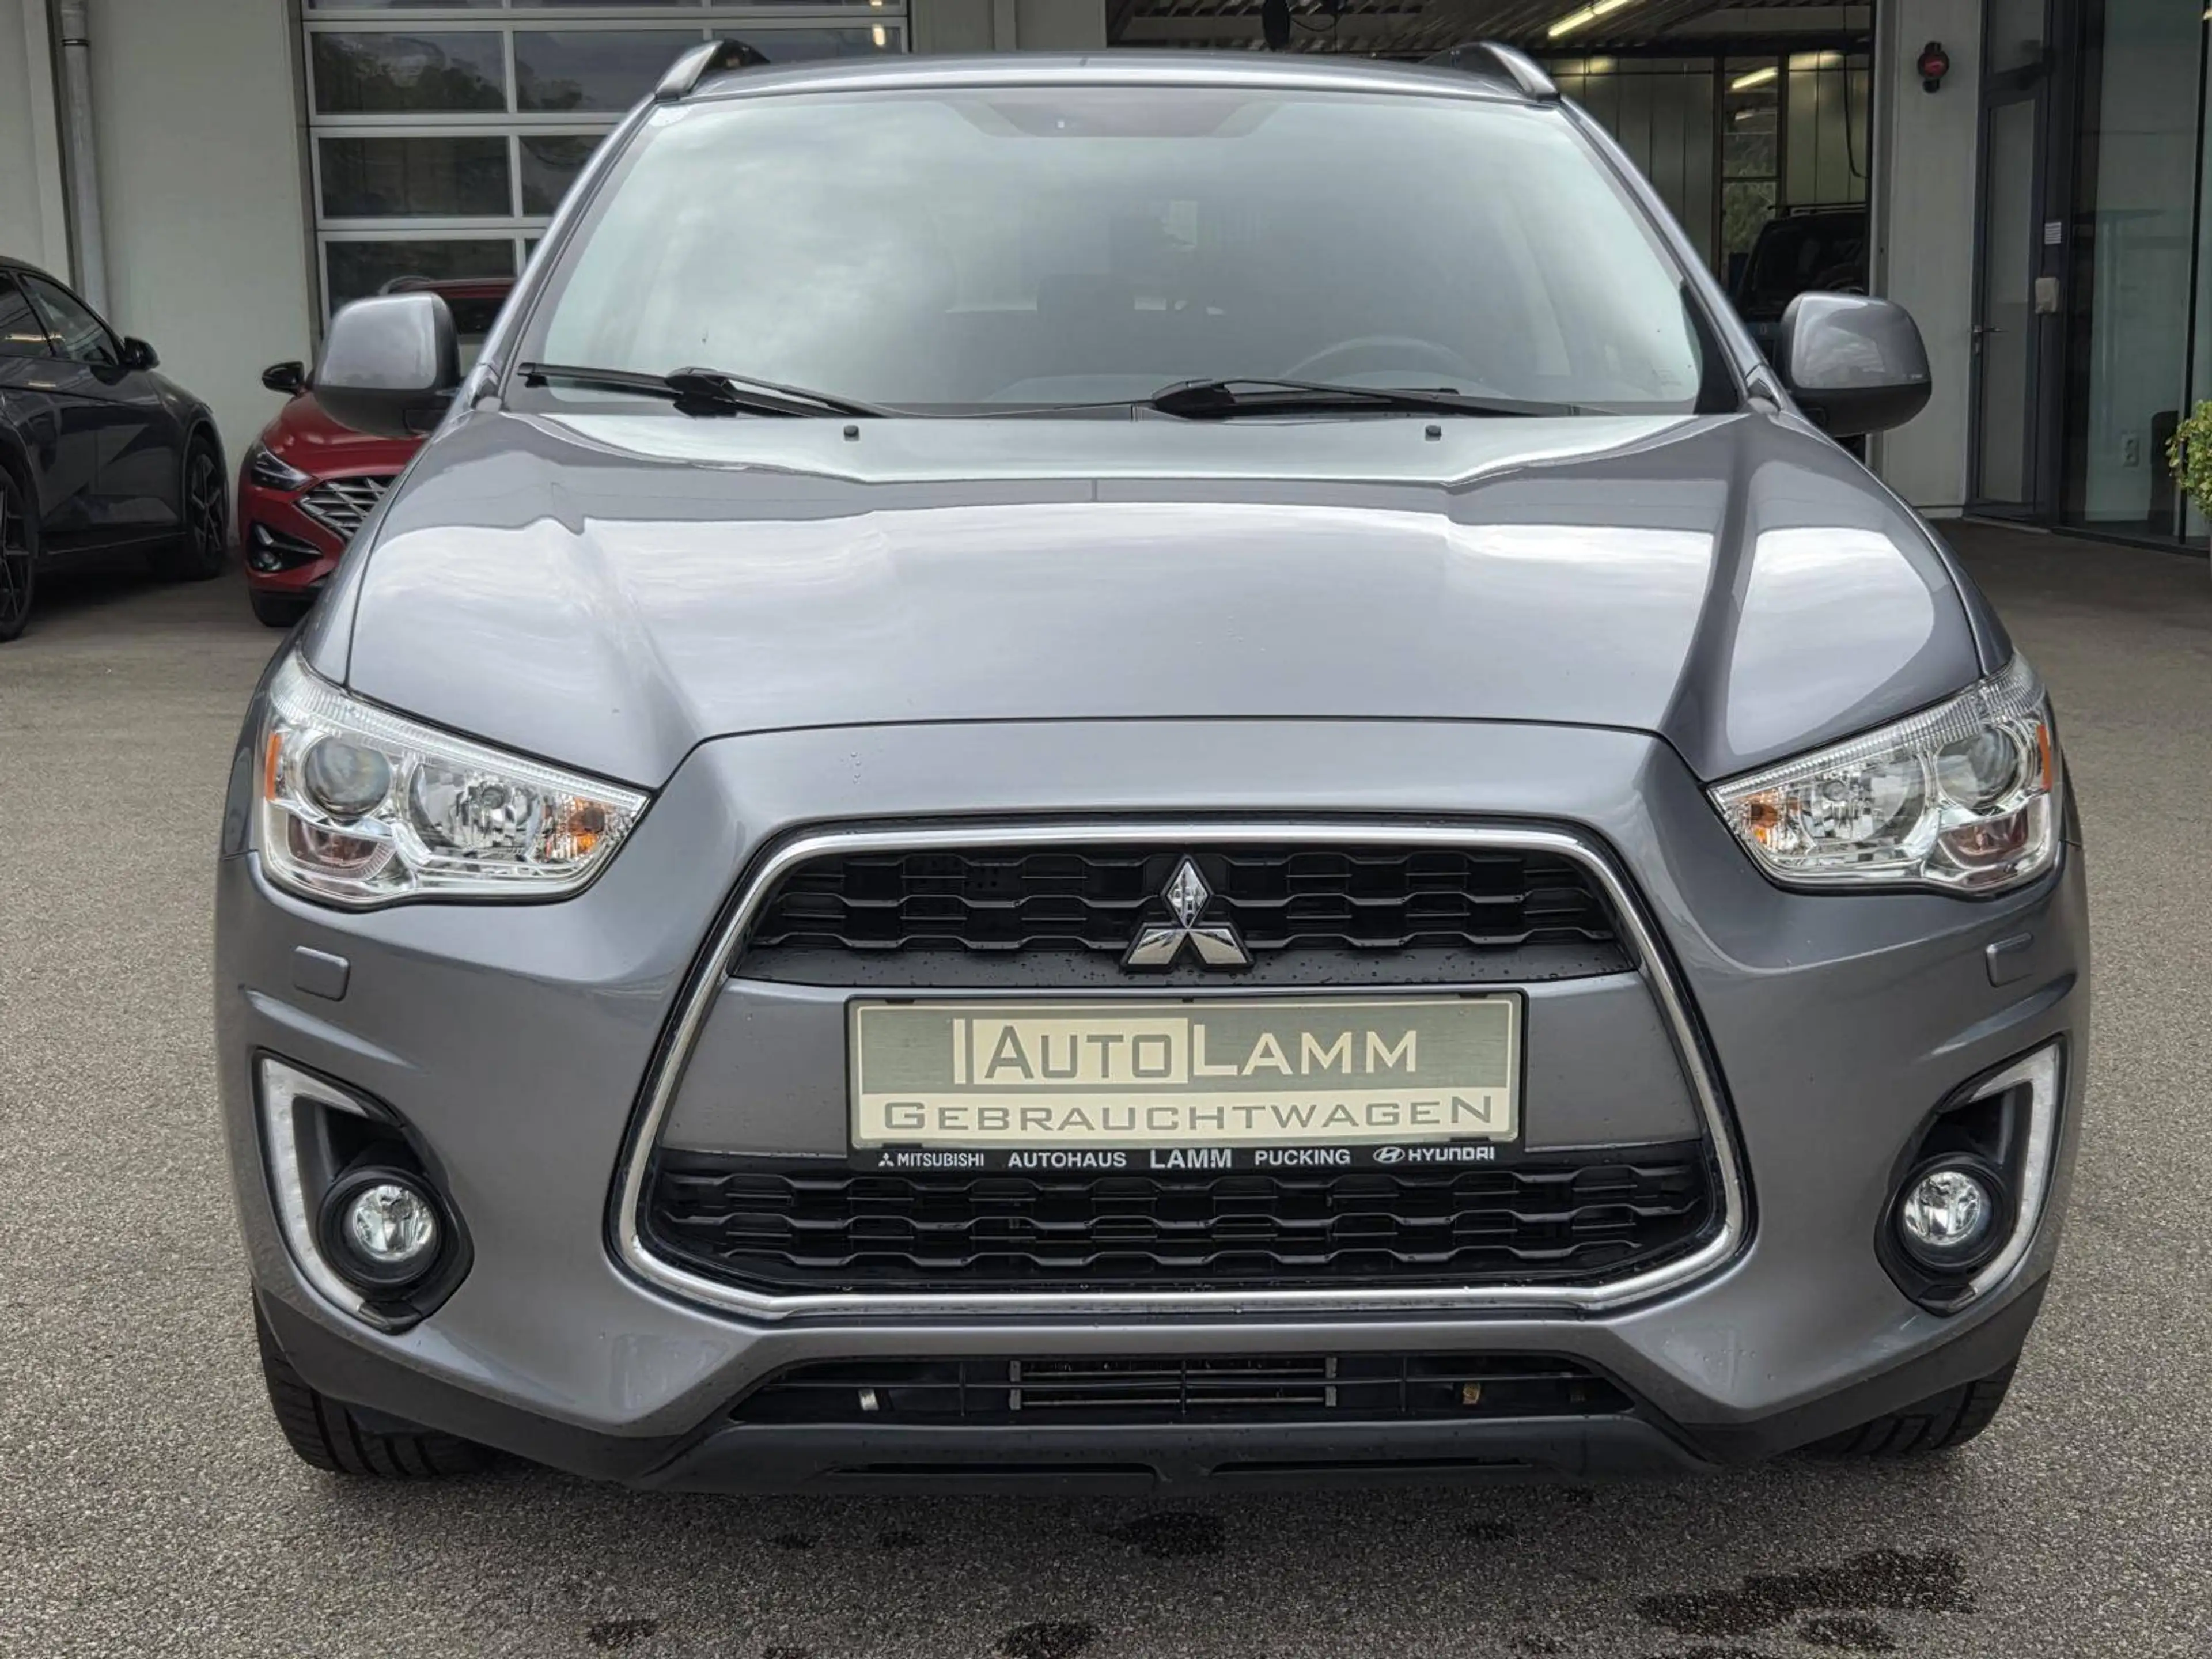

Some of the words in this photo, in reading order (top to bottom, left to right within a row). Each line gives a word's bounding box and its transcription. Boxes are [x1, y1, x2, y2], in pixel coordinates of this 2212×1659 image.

[884, 1096, 1491, 1131] GEBRAUCHTWAGEN
[897, 1152, 984, 1168] MITSUBISHI
[1008, 1151, 1127, 1168] AUTOHAUS
[1150, 1149, 1232, 1169] LAMM
[1255, 1149, 1351, 1166] PUCKING
[1408, 1146, 1495, 1162] HYUNDAI
